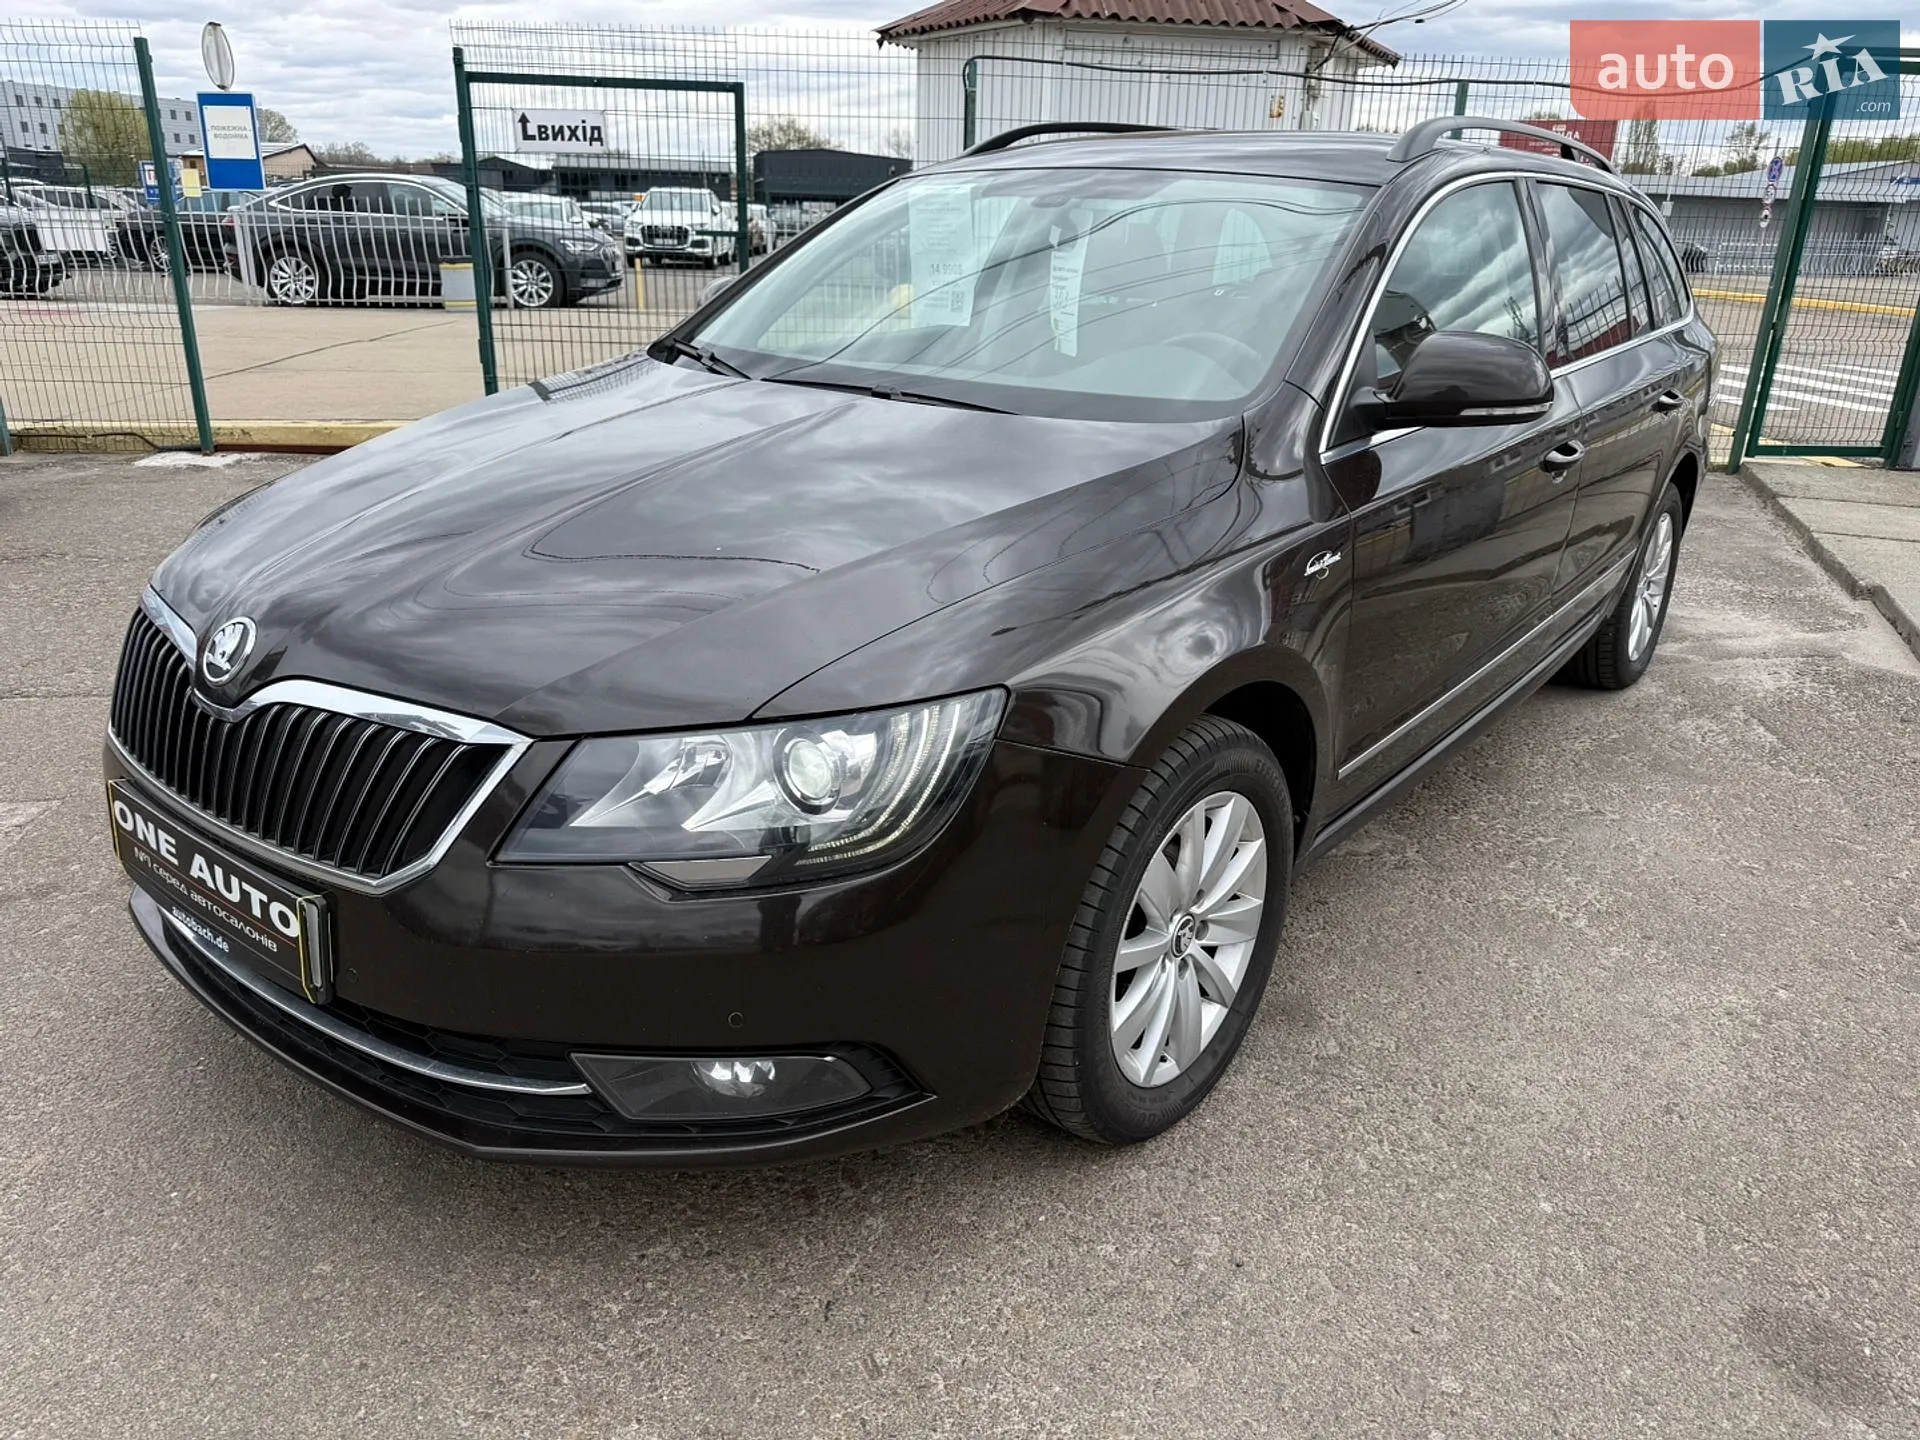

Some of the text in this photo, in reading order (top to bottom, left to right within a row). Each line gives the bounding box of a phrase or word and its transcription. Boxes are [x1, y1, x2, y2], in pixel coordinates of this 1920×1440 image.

[537, 119, 604, 147] вихід
[114, 800, 300, 938] ONE AUTO
[153, 863, 189, 896] серед
[190, 889, 278, 952] автосалонів
